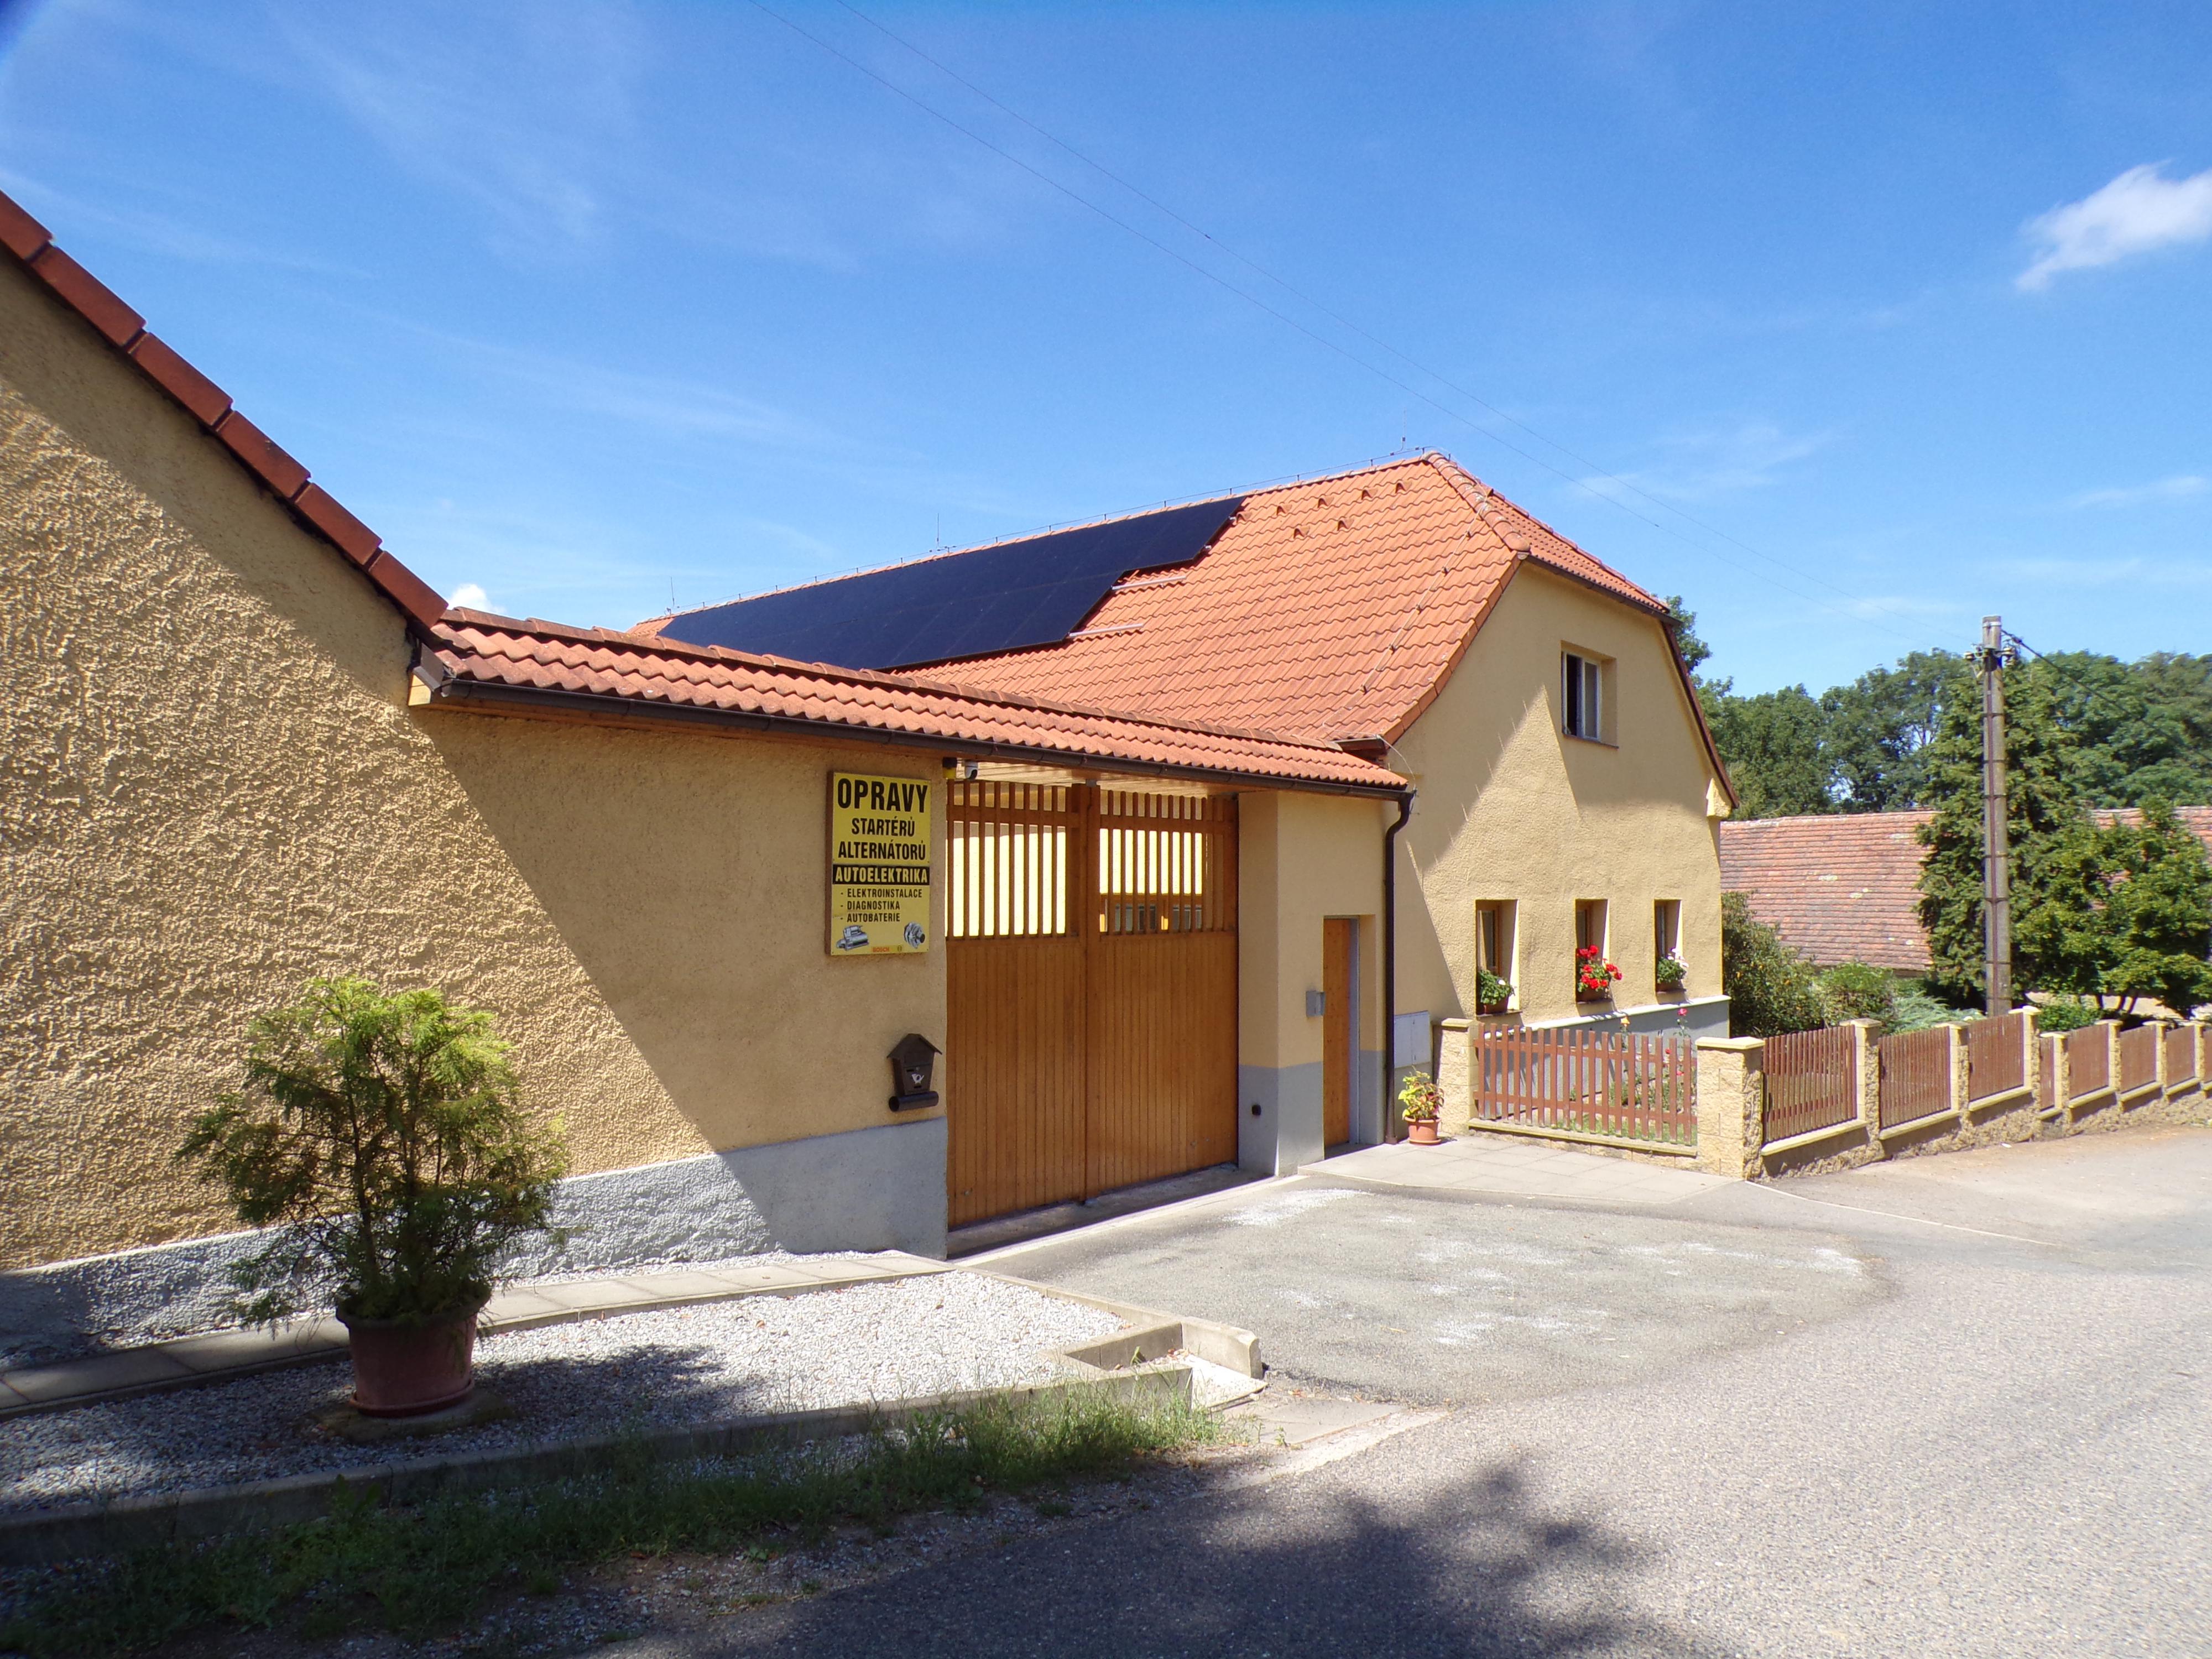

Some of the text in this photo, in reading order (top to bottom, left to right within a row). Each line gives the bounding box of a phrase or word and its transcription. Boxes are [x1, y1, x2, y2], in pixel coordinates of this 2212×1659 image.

[838, 778, 928, 813] OPRAVY
[852, 816, 915, 837] STARTÉRŮ
[838, 839, 926, 860] ALTERNÁTORŮ
[835, 867, 928, 883] AUTOELEKTRIKA
[847, 888, 922, 898] ELEKTROINSTALACE
[847, 901, 900, 910] DIAGNOSTIKA
[847, 913, 900, 922] AUTOBATERIE
